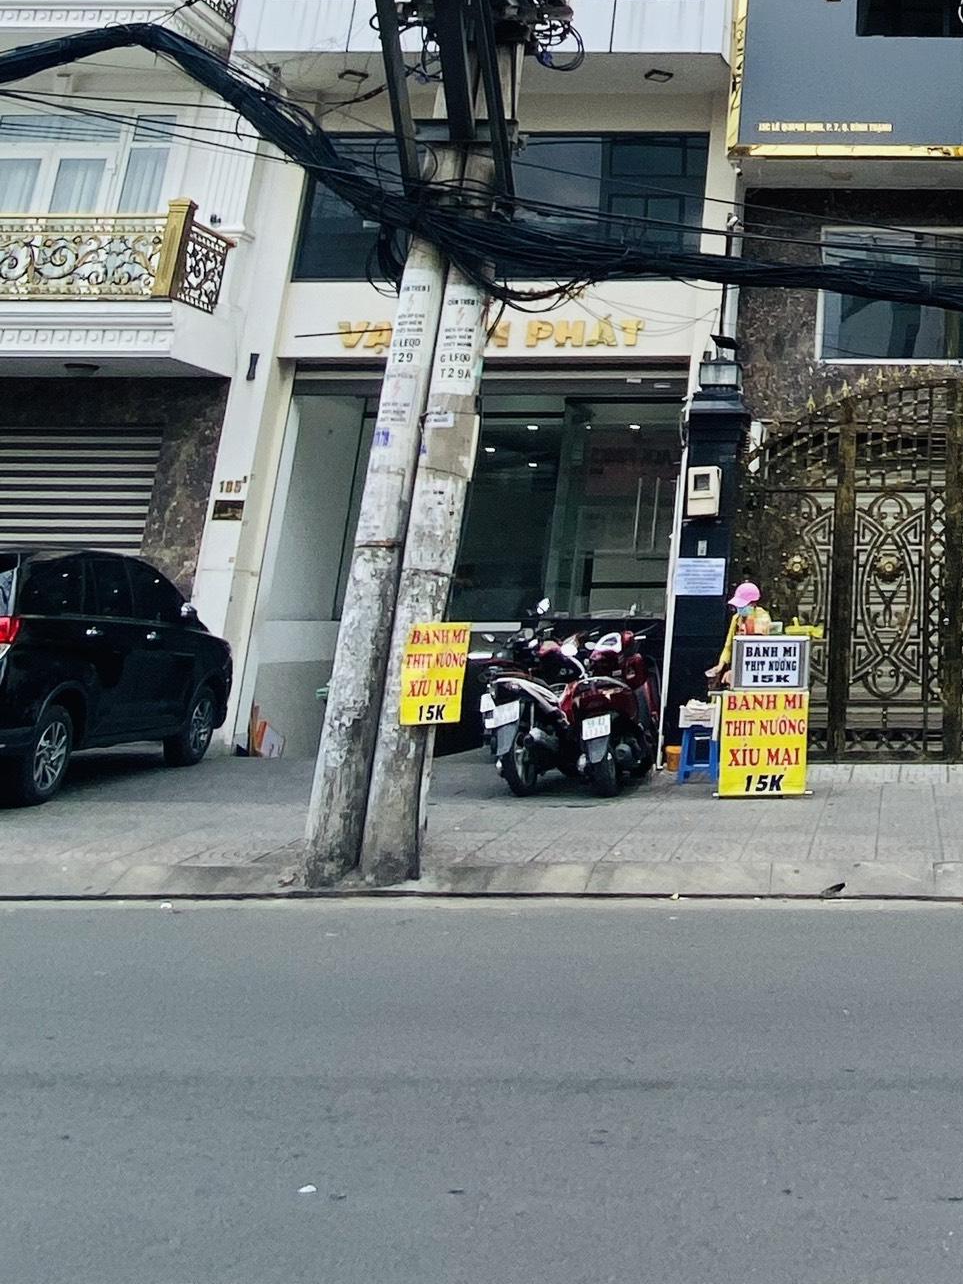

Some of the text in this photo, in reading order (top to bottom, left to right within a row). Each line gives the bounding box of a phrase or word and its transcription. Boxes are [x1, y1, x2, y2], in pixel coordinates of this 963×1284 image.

[338, 321, 393, 354] VẠ
[525, 315, 645, 348] PHÁT
[752, 675, 790, 683] 15K
[419, 704, 446, 722] 15K
[728, 744, 800, 771] XÍU MẠI
[745, 775, 784, 792] 15K
